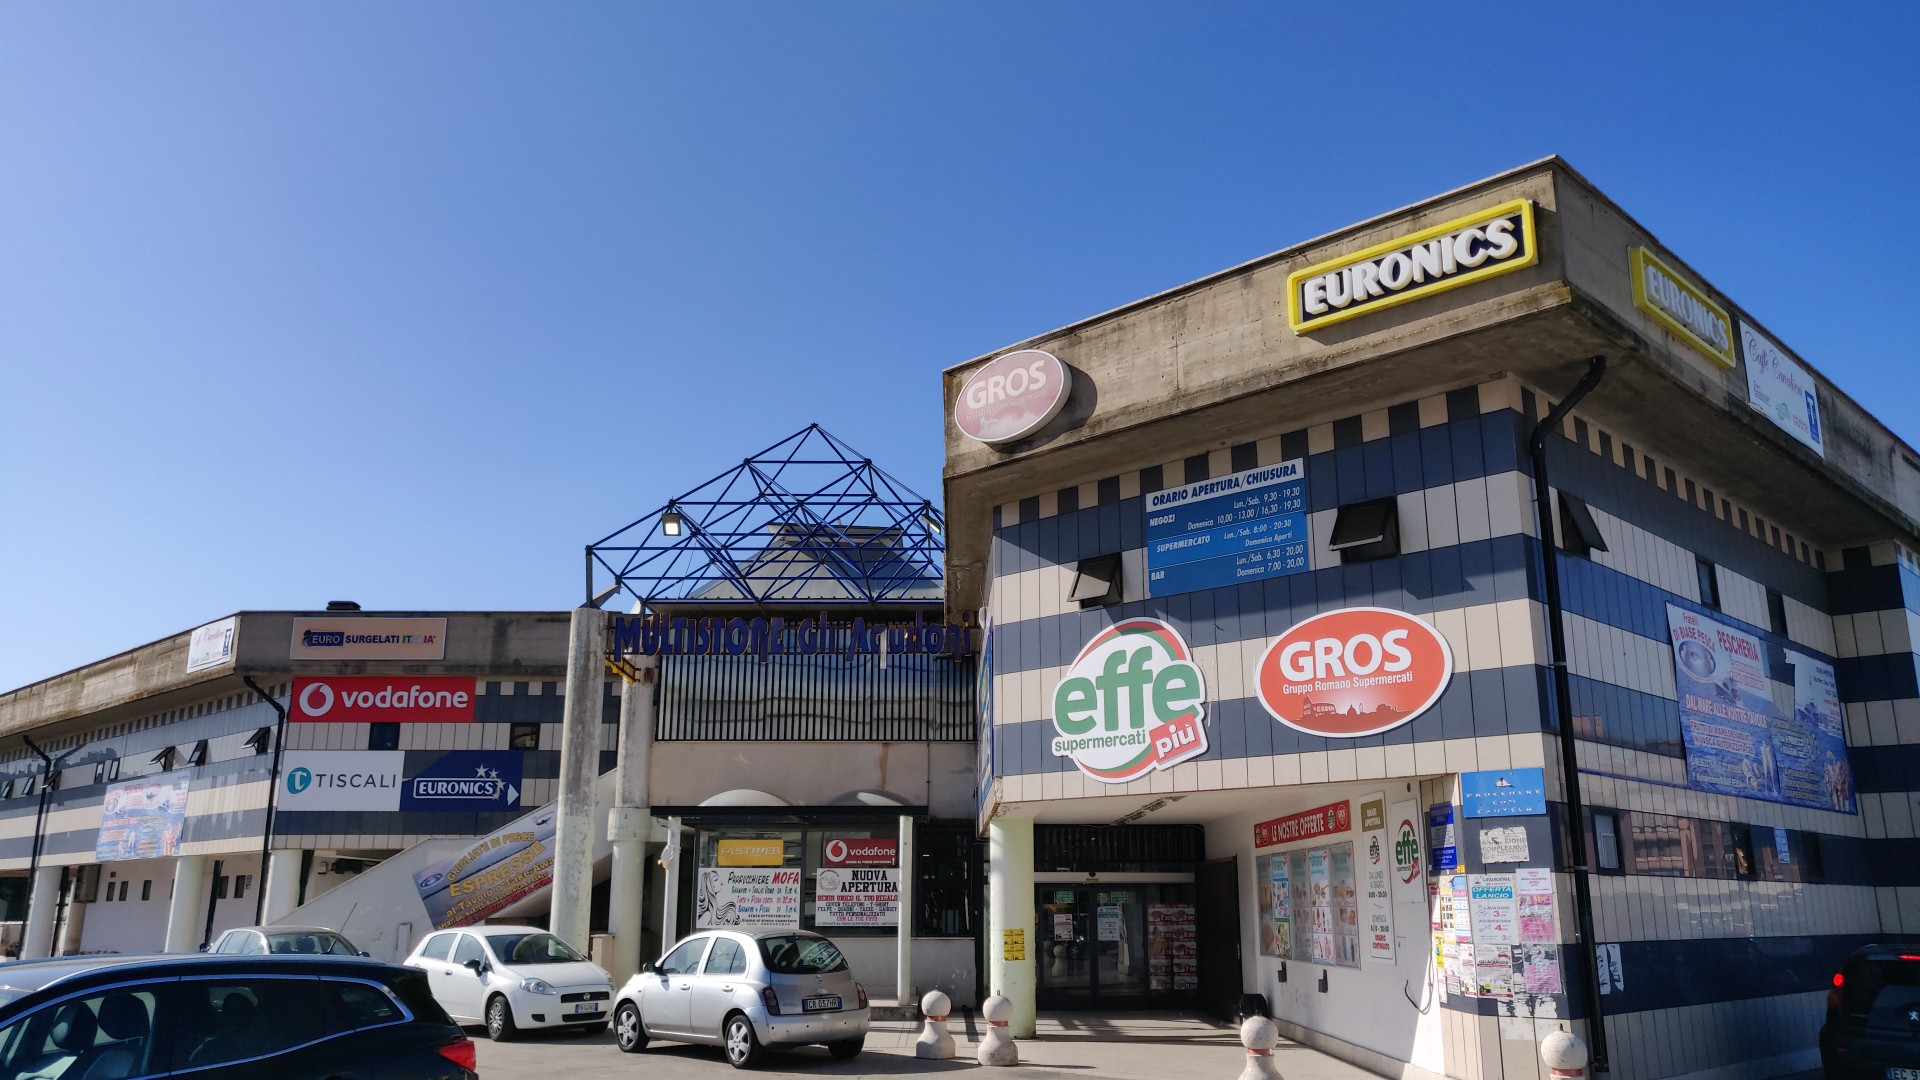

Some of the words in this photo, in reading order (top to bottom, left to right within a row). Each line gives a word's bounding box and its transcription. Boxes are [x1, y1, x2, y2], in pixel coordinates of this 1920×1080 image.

[1304, 219, 1518, 315] EURONICS
[1646, 265, 1729, 350] EURONICS
[966, 360, 1047, 409] GROS
[1152, 489, 1188, 506] ORARIO
[1264, 492, 1278, 502] 9,30
[1284, 487, 1300, 498] 19,30
[1150, 514, 1175, 527] NEGOZI
[1187, 520, 1213, 530] Domenica
[1217, 511, 1233, 525] 10,00
[1238, 509, 1254, 520] 13,00
[1261, 504, 1278, 515] 16,30
[1284, 499, 1301, 510] 19,30
[1253, 524, 1267, 533] 8:00
[1274, 519, 1292, 529] 20:30
[1156, 535, 1211, 553] SUPERMERCATO
[1245, 536, 1272, 546] Domenica
[1274, 531, 1293, 542] Aperti
[1267, 549, 1280, 560] 6,30
[1286, 545, 1303, 556] 20,00
[1151, 571, 1165, 580] BAR
[1237, 565, 1264, 577] Domenica
[1268, 561, 1281, 572] 7,00
[1287, 557, 1304, 568] 20,00
[311, 634, 340, 645] EURO
[345, 634, 400, 644] SURGELATI
[614, 613, 784, 663] MULTISTORE
[798, 610, 837, 655] Gli
[845, 609, 971, 669] Aquiloni
[1673, 628, 1679, 641] DI
[1679, 626, 1697, 640] BIASE
[1697, 629, 1715, 652] PESCA
[1717, 630, 1760, 662] PESCHERIA
[1280, 628, 1412, 682] GROS
[1055, 645, 1201, 735] effe
[1283, 684, 1313, 695] Gruppo
[1315, 679, 1350, 692] Romano
[1353, 671, 1413, 688] Supermercati
[340, 684, 468, 709] vodafone
[1055, 729, 1146, 754] supermercati
[1155, 723, 1196, 759] più
[315, 773, 397, 788] TISCALI
[418, 781, 494, 796] EURONICS
[1466, 789, 1541, 798] PROCEDERE
[1477, 806, 1533, 814] CAUTELA
[1271, 824, 1278, 842] LE
[1278, 819, 1298, 840] NOSTRE
[1300, 813, 1324, 836] OFFERTE
[447, 841, 490, 881] GRIGLIATE
[490, 837, 501, 848] DI
[503, 832, 535, 844] PESCE
[720, 846, 780, 857] FASTWEB
[850, 846, 896, 856] vodafone
[1369, 841, 1380, 857] effe
[1396, 830, 1419, 866] effe
[449, 841, 546, 897] ESPRESSE
[852, 870, 888, 881] NUOVA
[771, 871, 800, 885] MOFA
[840, 882, 899, 893] APERTURA
[446, 907, 457, 918] al
[458, 889, 493, 910] Tavolo
[808, 1000, 817, 1009] CR
[1893, 1068, 1906, 1080] EC
